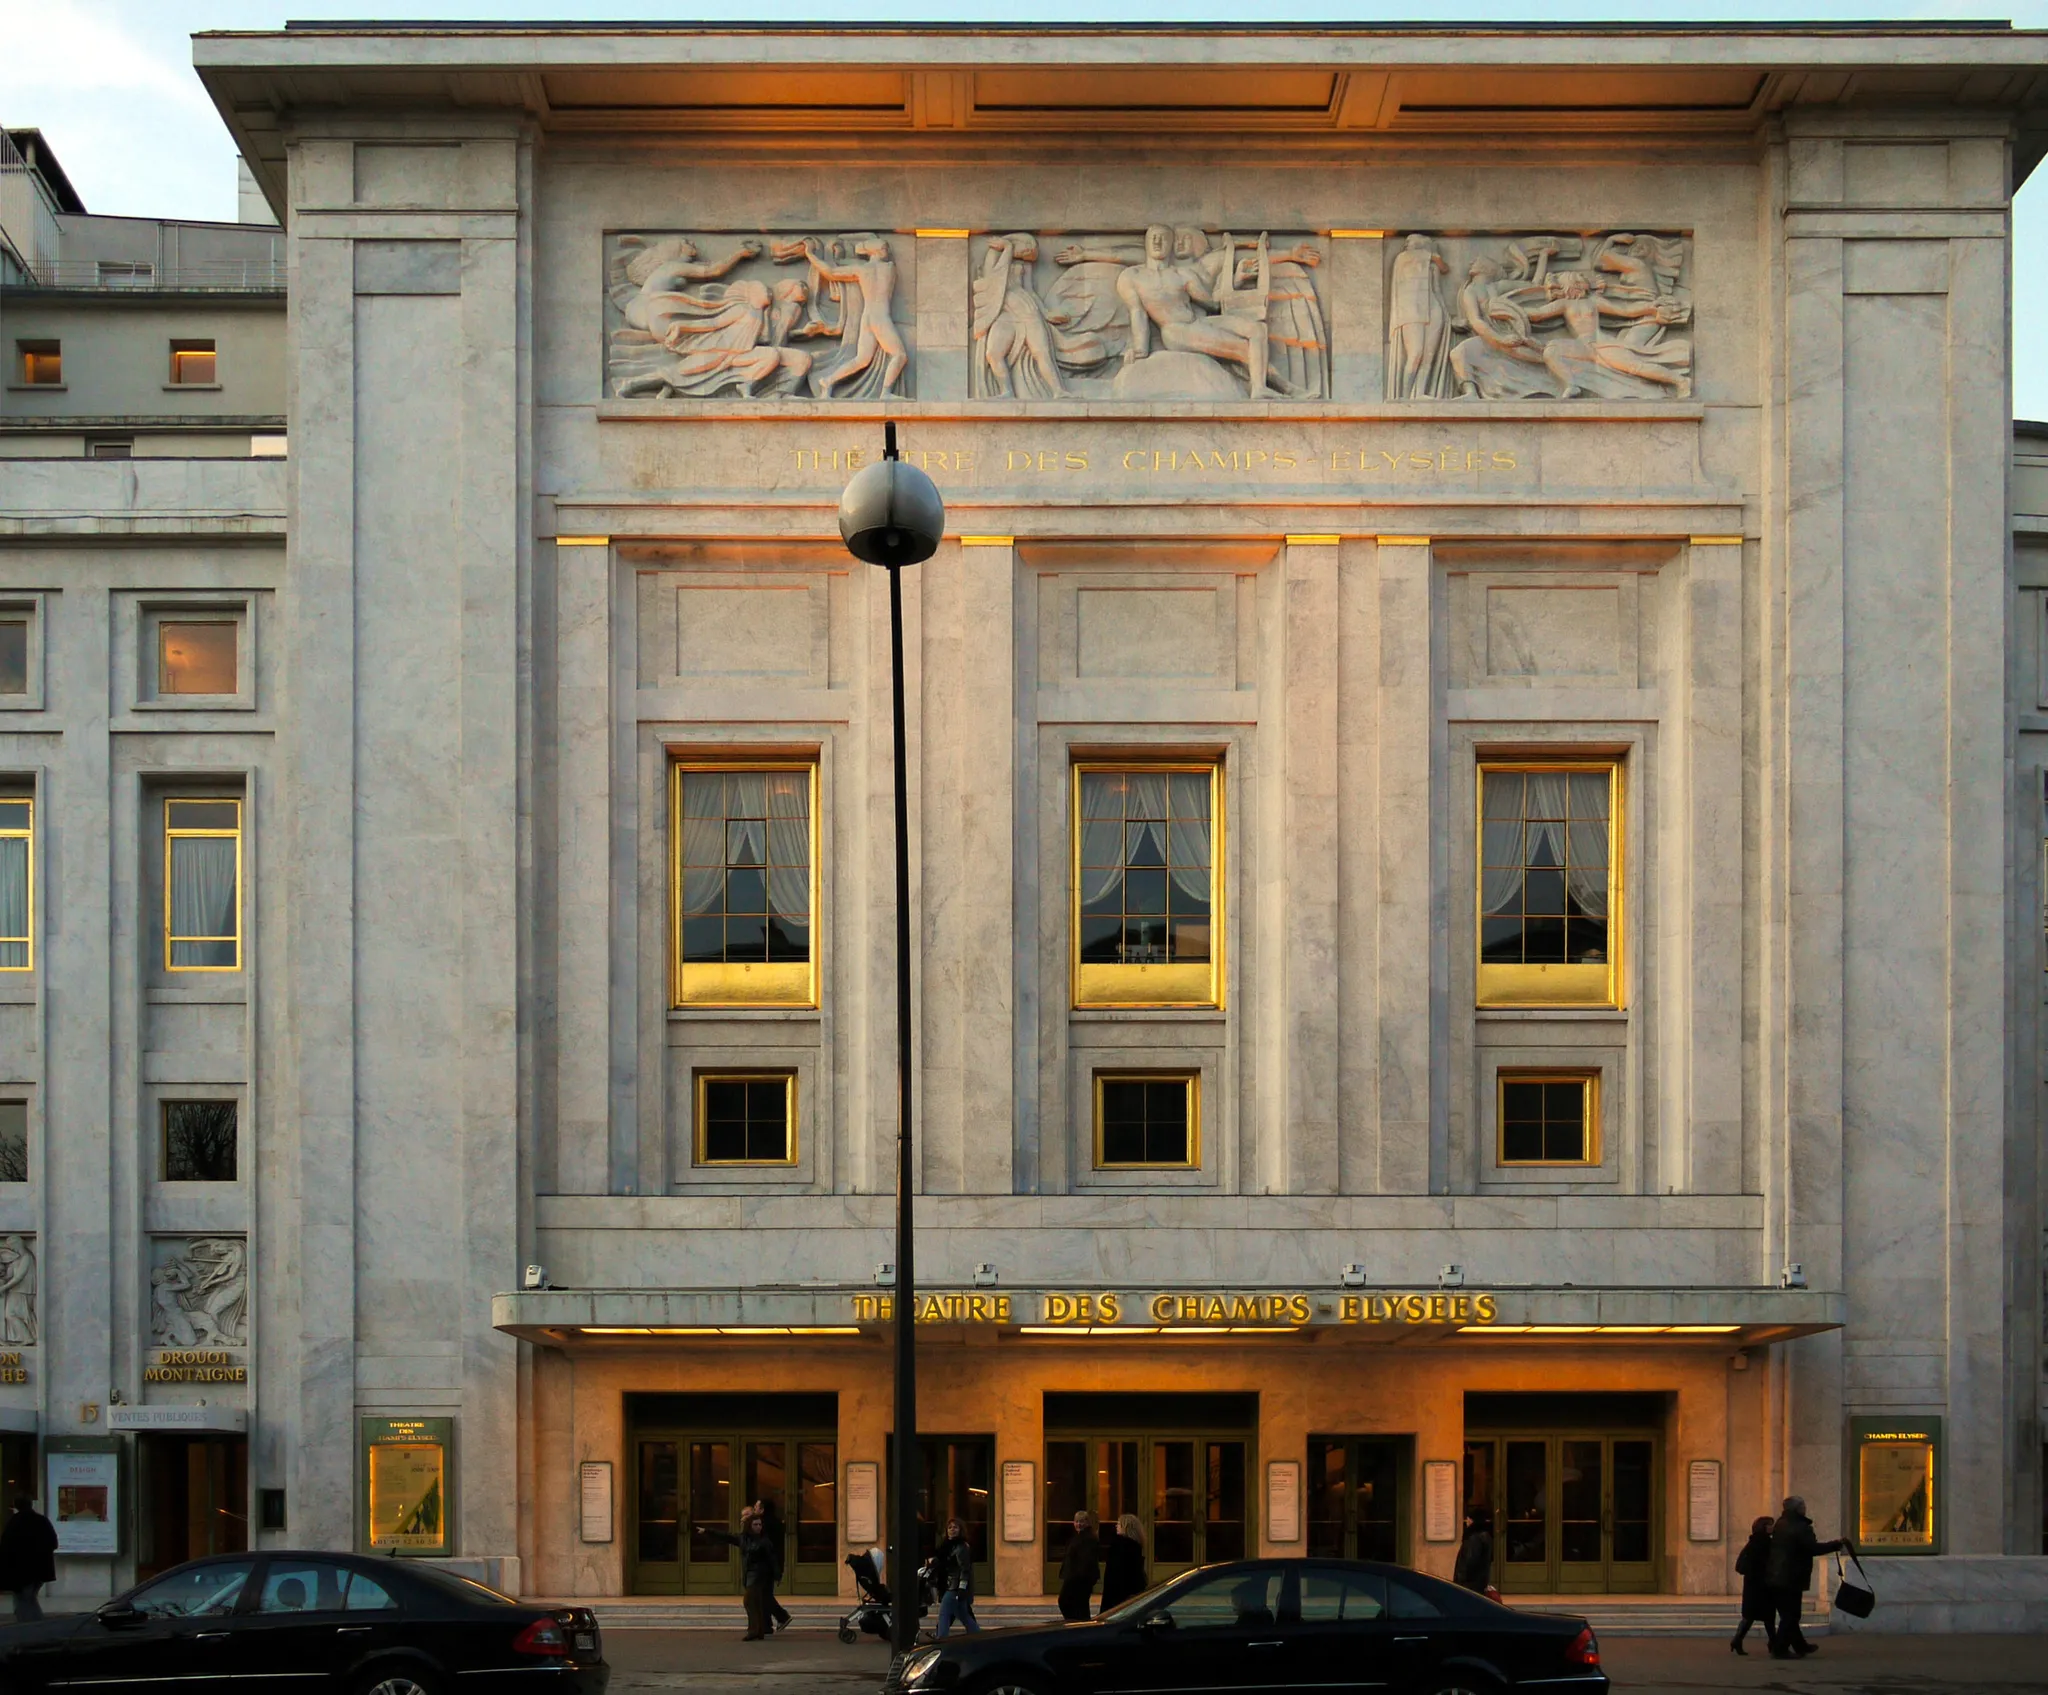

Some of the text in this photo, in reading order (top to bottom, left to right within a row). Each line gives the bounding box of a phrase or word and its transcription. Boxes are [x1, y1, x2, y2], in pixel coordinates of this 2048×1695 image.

[789, 445, 977, 471] THÉTRE
[1007, 449, 1088, 471] DES
[1045, 1294, 1118, 1322] DES
[160, 1351, 229, 1364] DROUOT
[144, 1368, 245, 1381] MONTAIGNE
[80, 1403, 99, 1423] 15
[111, 1412, 207, 1422] VENTES PUBLIQUES
